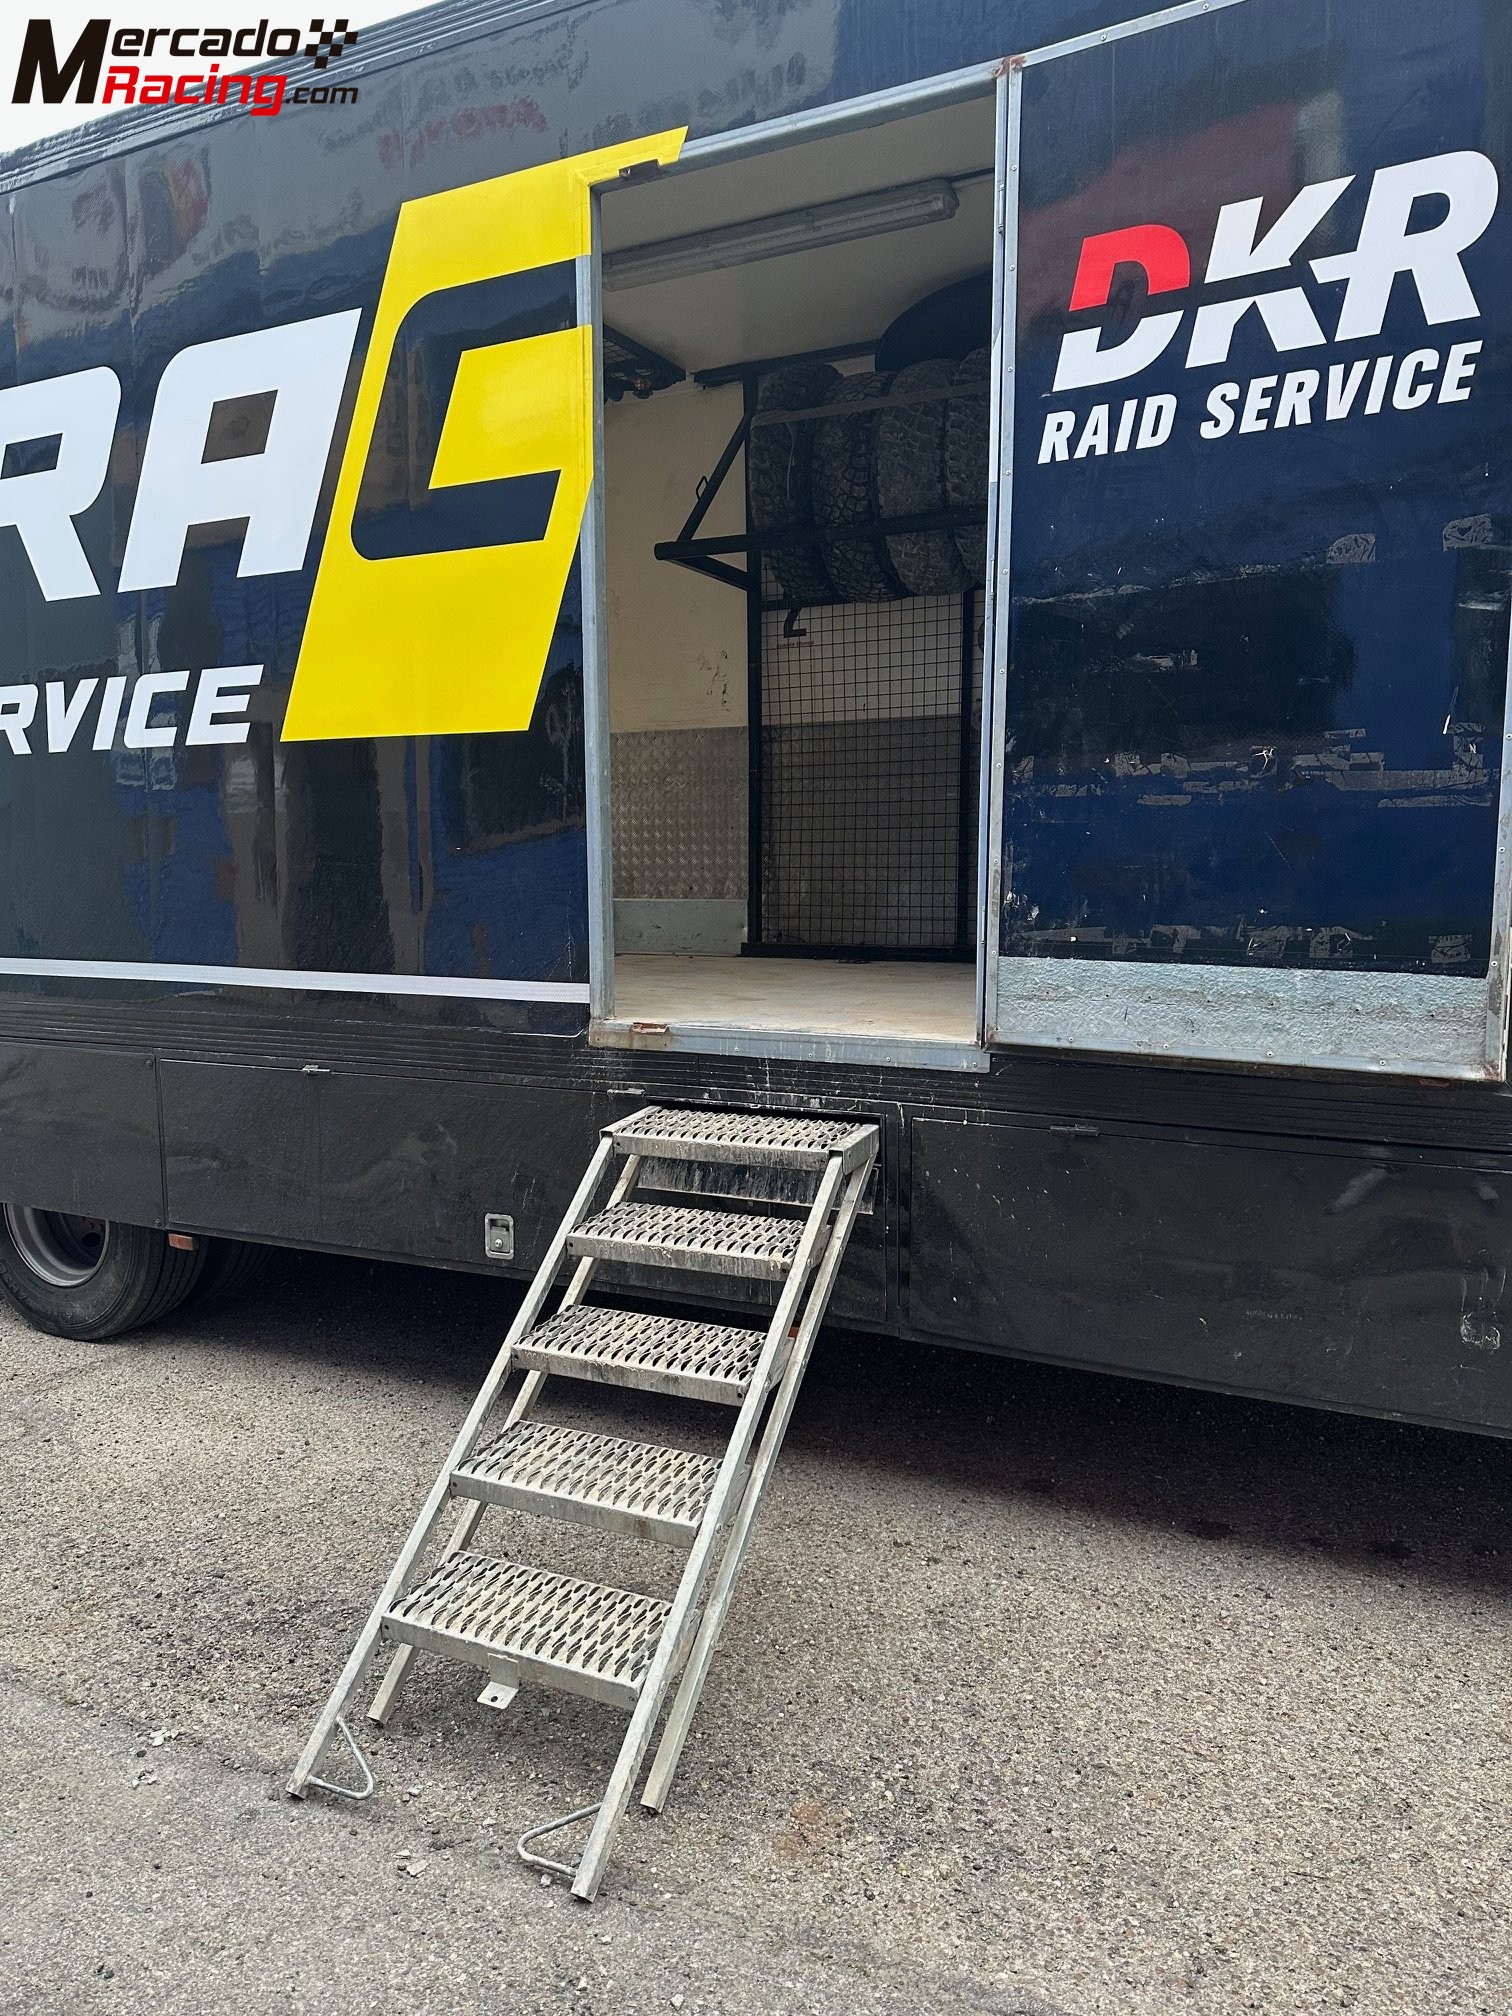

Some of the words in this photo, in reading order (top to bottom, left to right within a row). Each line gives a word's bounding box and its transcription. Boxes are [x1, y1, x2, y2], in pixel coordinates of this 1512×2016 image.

[1052, 150, 1499, 392] DKR
[1037, 393, 1178, 464] RAID
[1200, 340, 1484, 439] SERVICE
